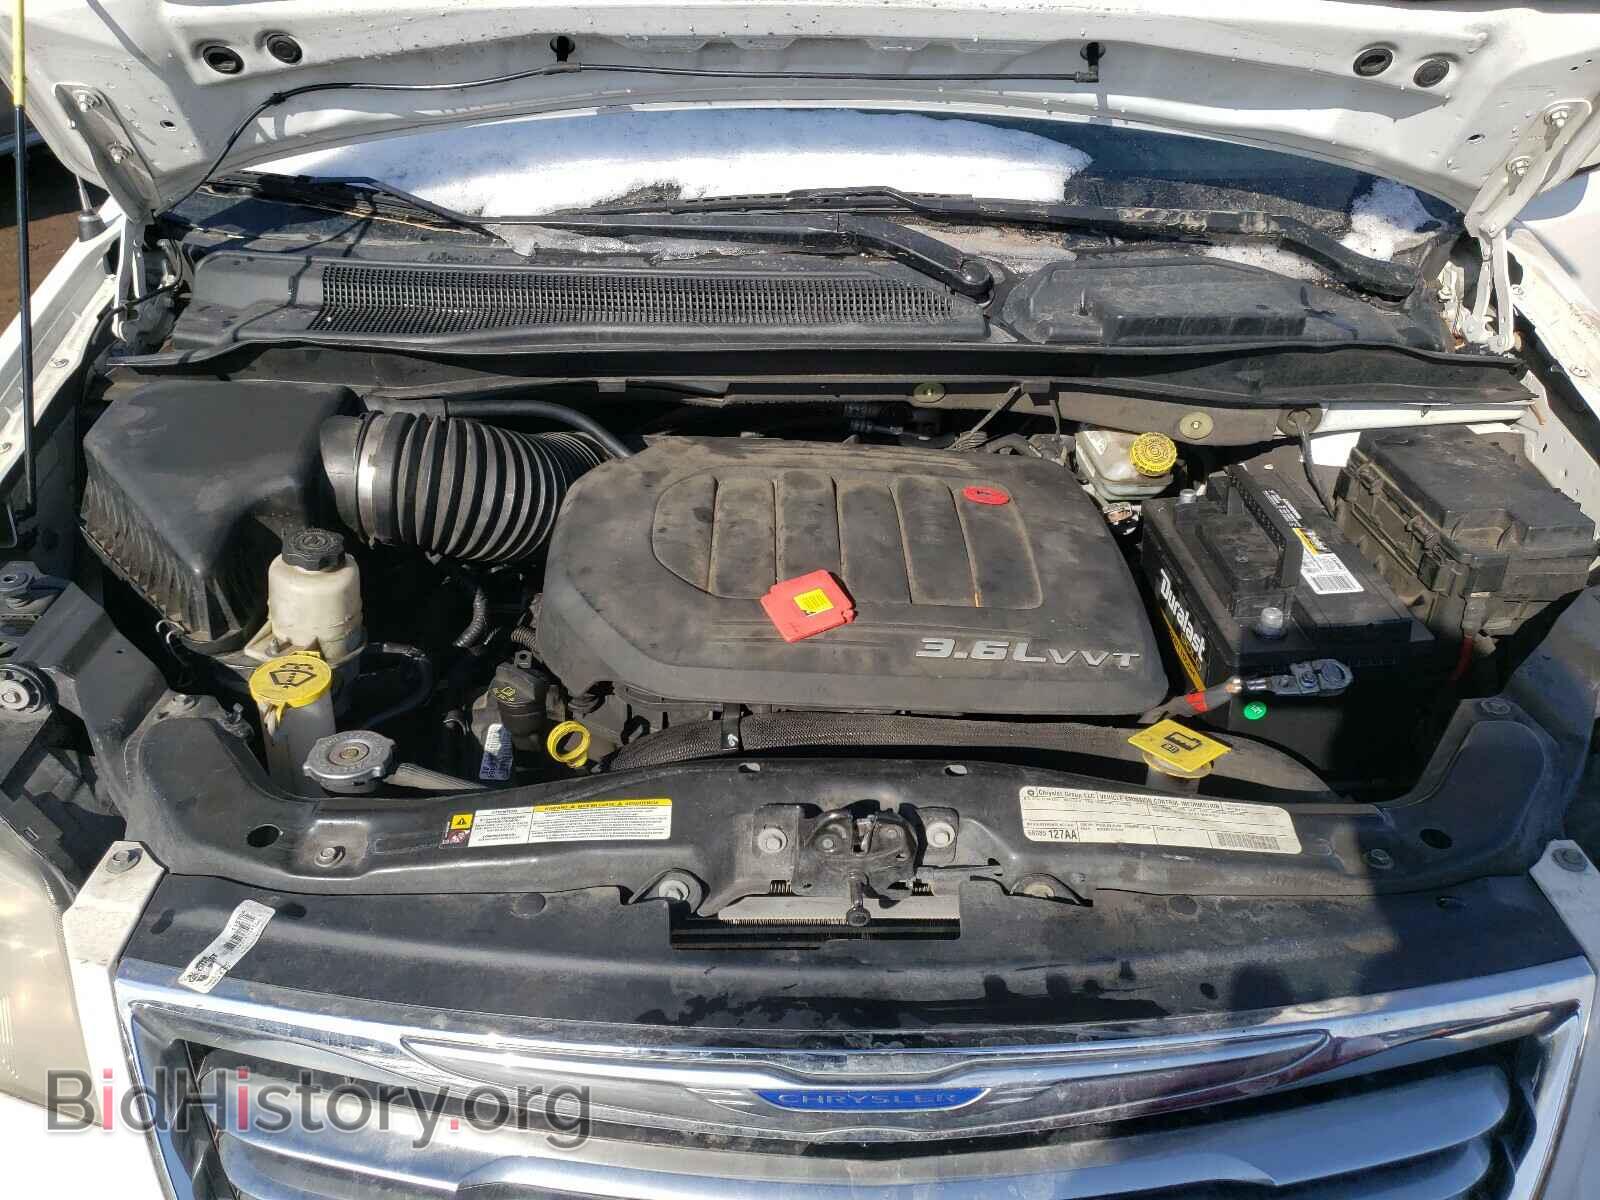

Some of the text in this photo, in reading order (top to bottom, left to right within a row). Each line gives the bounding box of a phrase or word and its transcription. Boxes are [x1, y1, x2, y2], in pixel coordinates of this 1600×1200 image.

[1160, 567, 1206, 663] Duralast
[915, 637, 1140, 668] 3.6L VVT
[1049, 829, 1078, 840] 127AA
[778, 1093, 957, 1106] CHRYSLER
